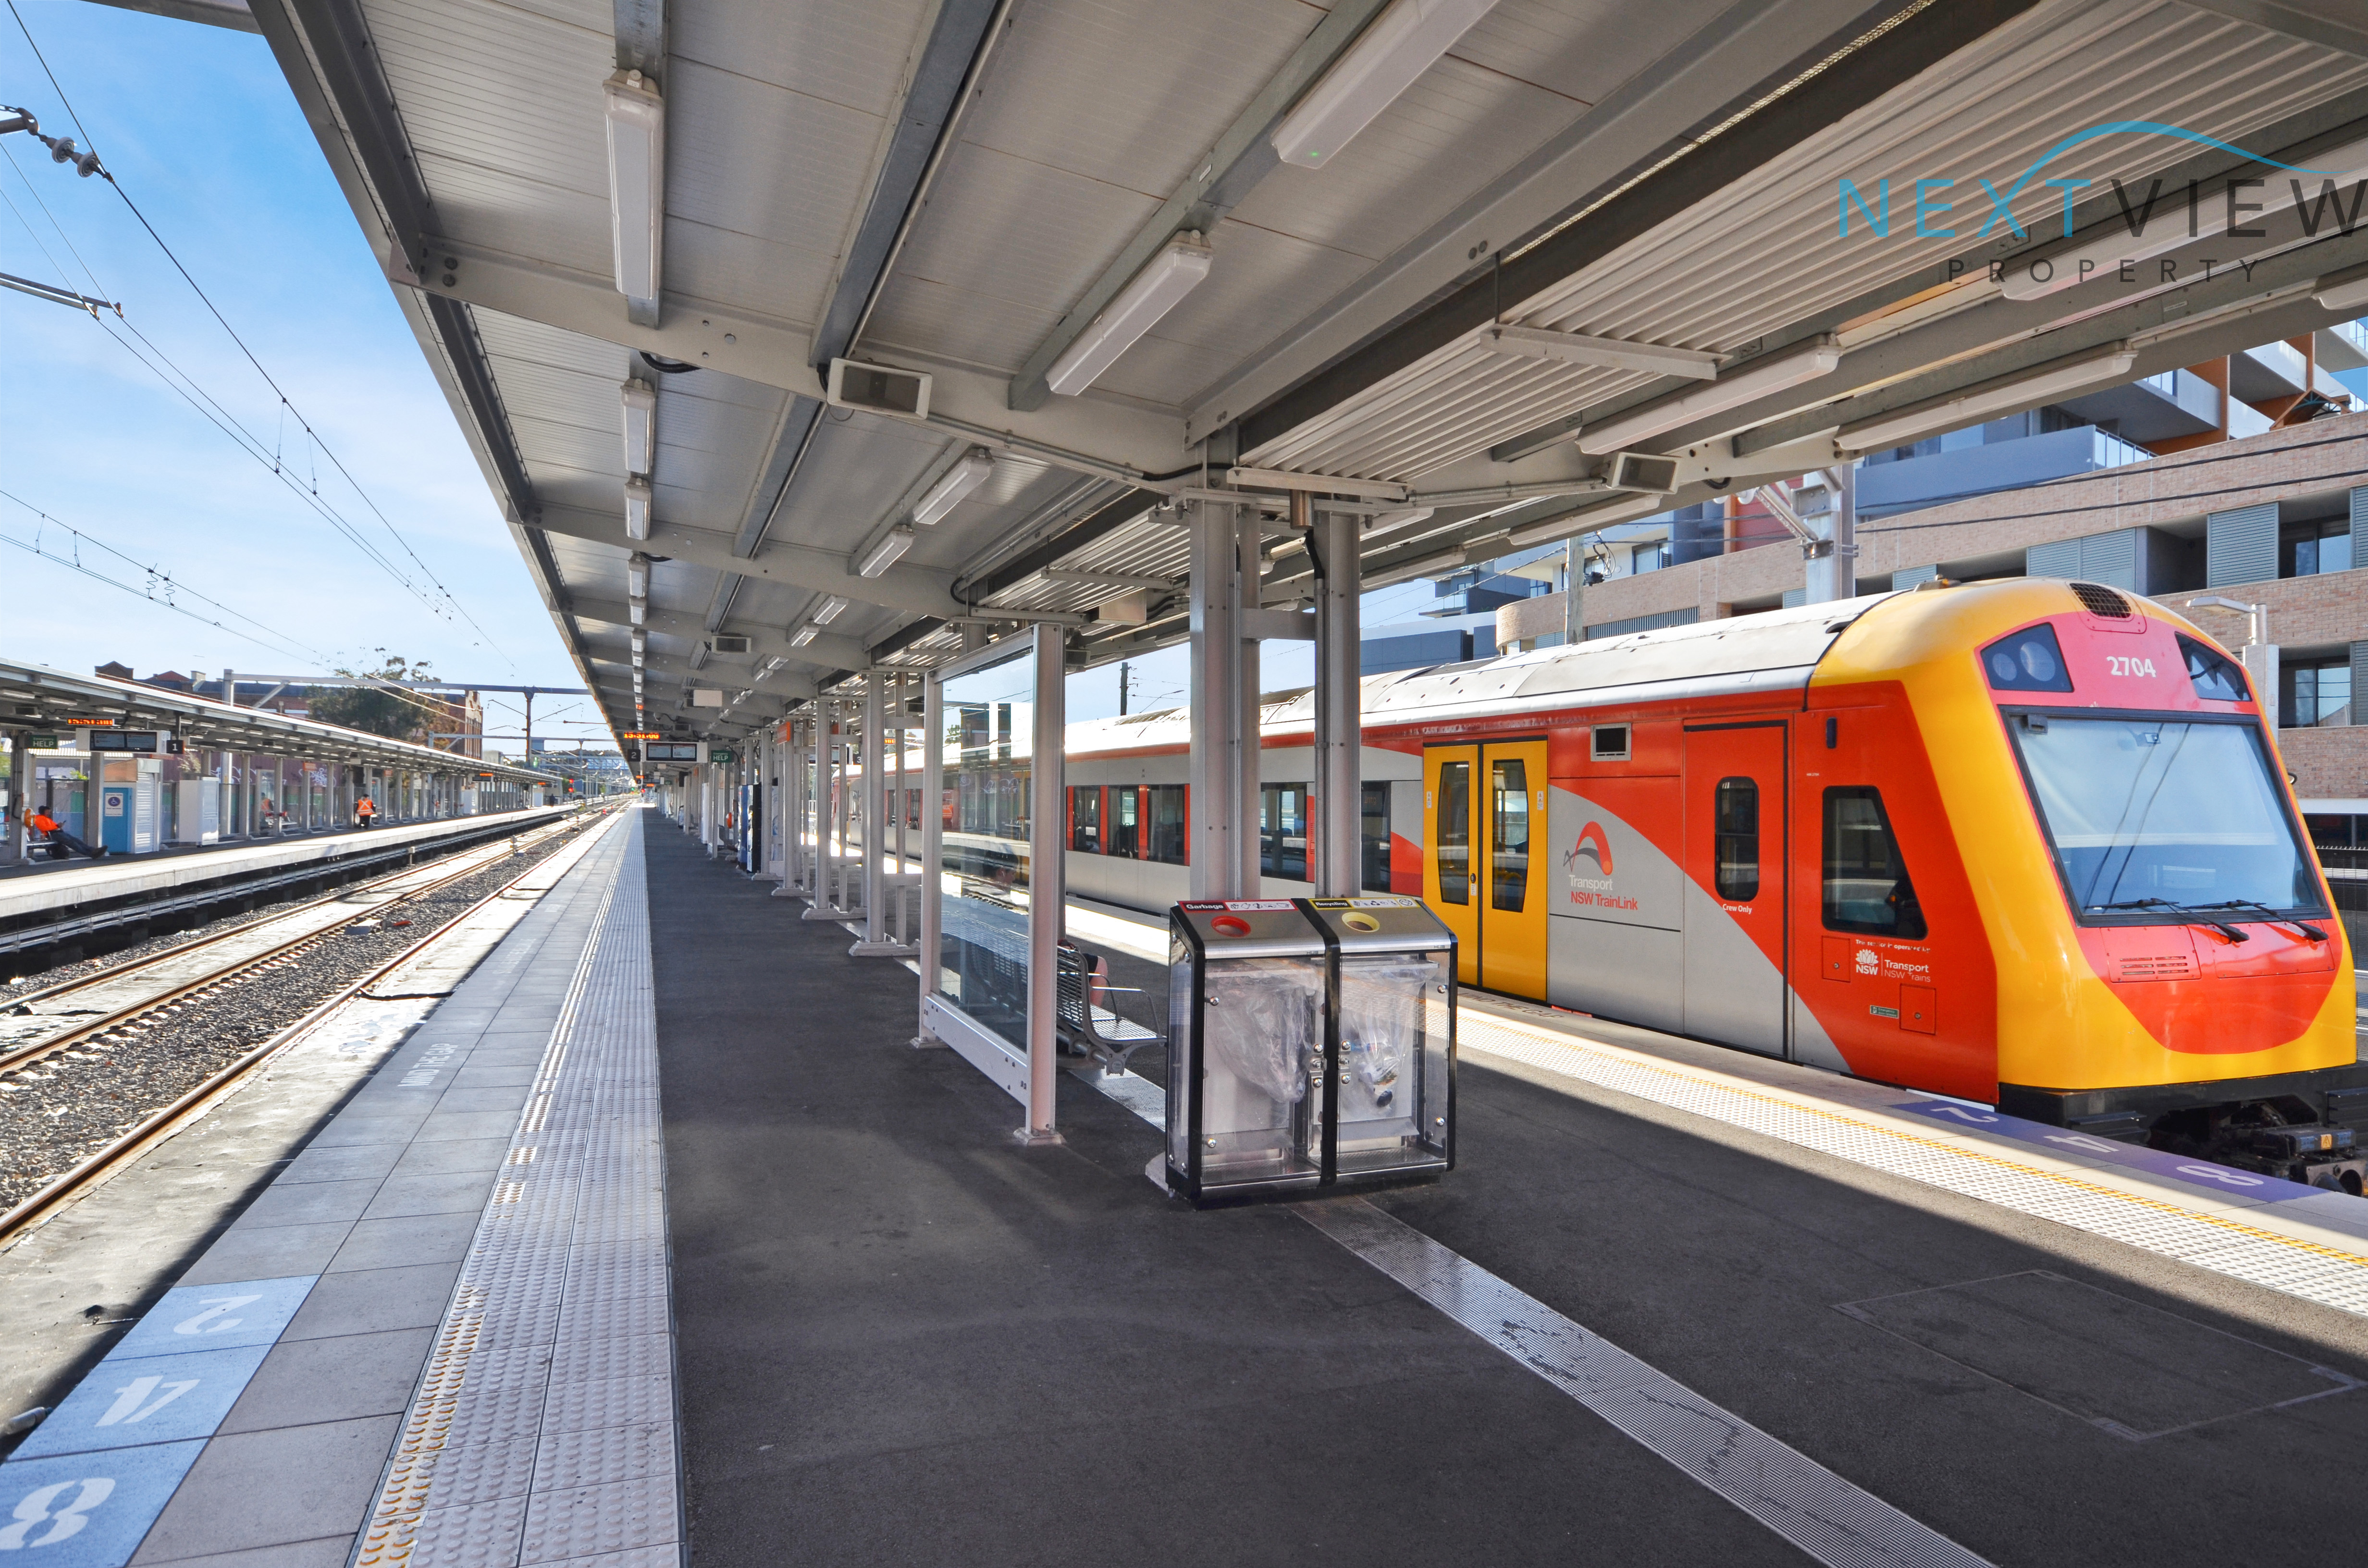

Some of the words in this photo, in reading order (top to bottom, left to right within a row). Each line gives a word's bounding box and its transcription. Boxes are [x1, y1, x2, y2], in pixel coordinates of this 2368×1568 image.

[2107, 656, 2156, 677] 2704
[1569, 874, 1613, 892] Transport
[1571, 891, 1594, 905] NSW
[1595, 893, 1638, 910] TrainLink
[1738, 905, 1752, 915] Only
[1856, 964, 1878, 975] NSW
[1885, 960, 1929, 973] Transport
[1885, 969, 1905, 979] NSW
[1908, 972, 1931, 982] Trains
[1931, 1107, 1999, 1123] 2
[2043, 1135, 2119, 1152] 4
[2176, 1165, 2264, 1186] 8
[173, 1294, 263, 1335] 2
[95, 1375, 201, 1427] 4
[0, 1478, 115, 1550] 8
